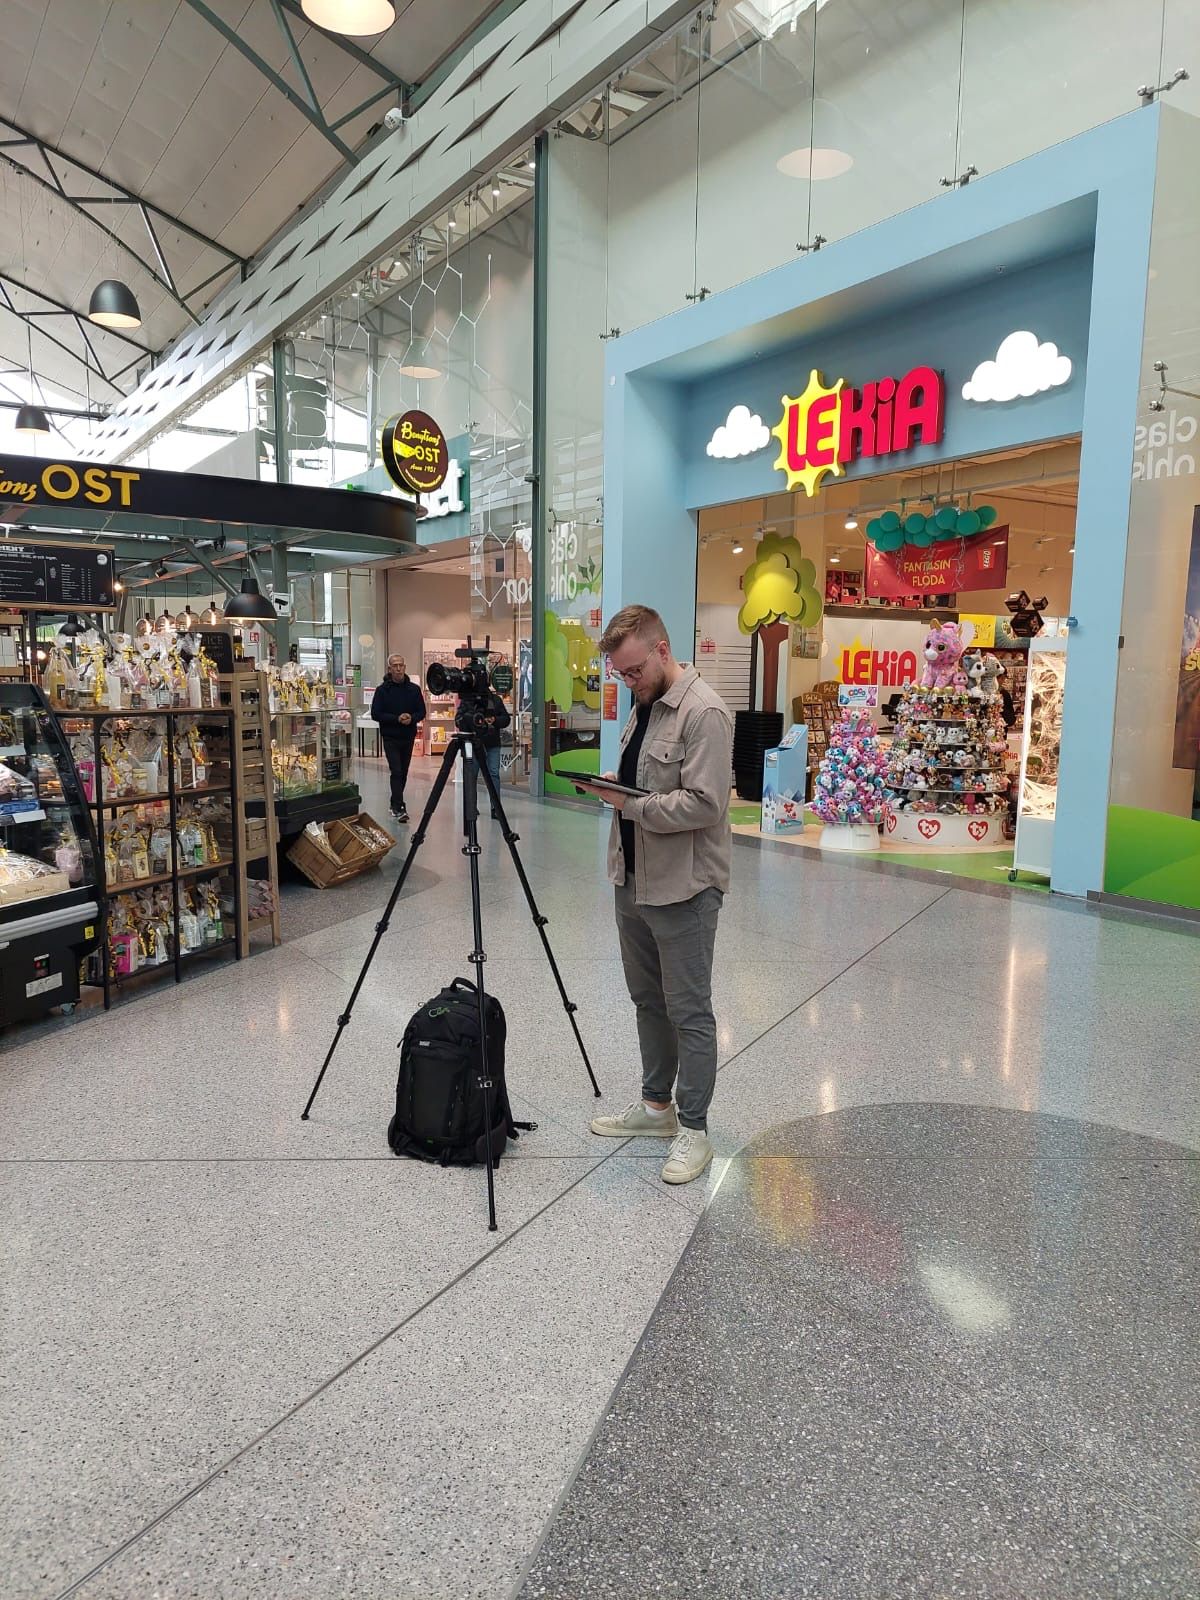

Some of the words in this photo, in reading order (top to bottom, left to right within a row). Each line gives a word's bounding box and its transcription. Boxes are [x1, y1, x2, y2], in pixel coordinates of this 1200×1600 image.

[414, 445, 441, 464] OST
[41, 463, 141, 507] OST
[912, 571, 946, 588] FLÖDA
[918, 820, 938, 836] ty
[969, 821, 987, 838] ty
